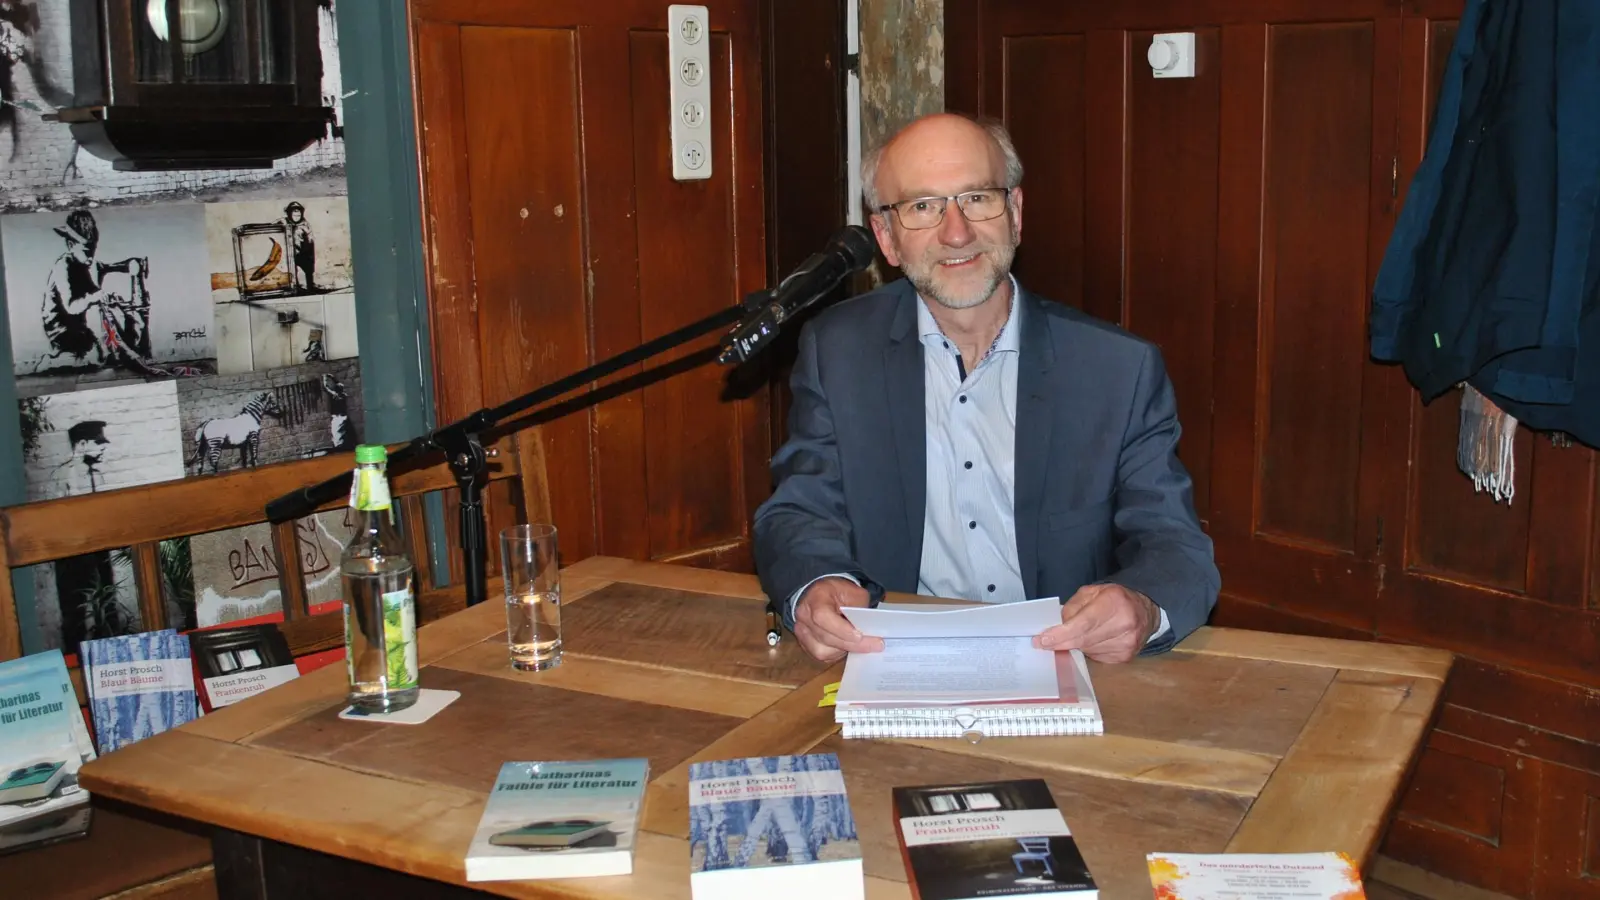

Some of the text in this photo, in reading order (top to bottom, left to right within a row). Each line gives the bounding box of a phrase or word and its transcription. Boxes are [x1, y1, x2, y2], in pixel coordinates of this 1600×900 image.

[100, 664, 163, 678] Horst Prosch
[101, 675, 164, 688] Blaue Bäume
[212, 673, 267, 689] Horst Prosch
[214, 683, 265, 697] Frankenruh
[1, 701, 64, 724] für Literatur
[530, 770, 612, 780] Katharinas
[701, 775, 796, 789] Horst Prosch
[498, 779, 637, 792] Faible für Literatur
[701, 788, 741, 797] Blaue
[913, 814, 1006, 828] Horst Prosch
[915, 823, 1001, 836] Frankenruh
